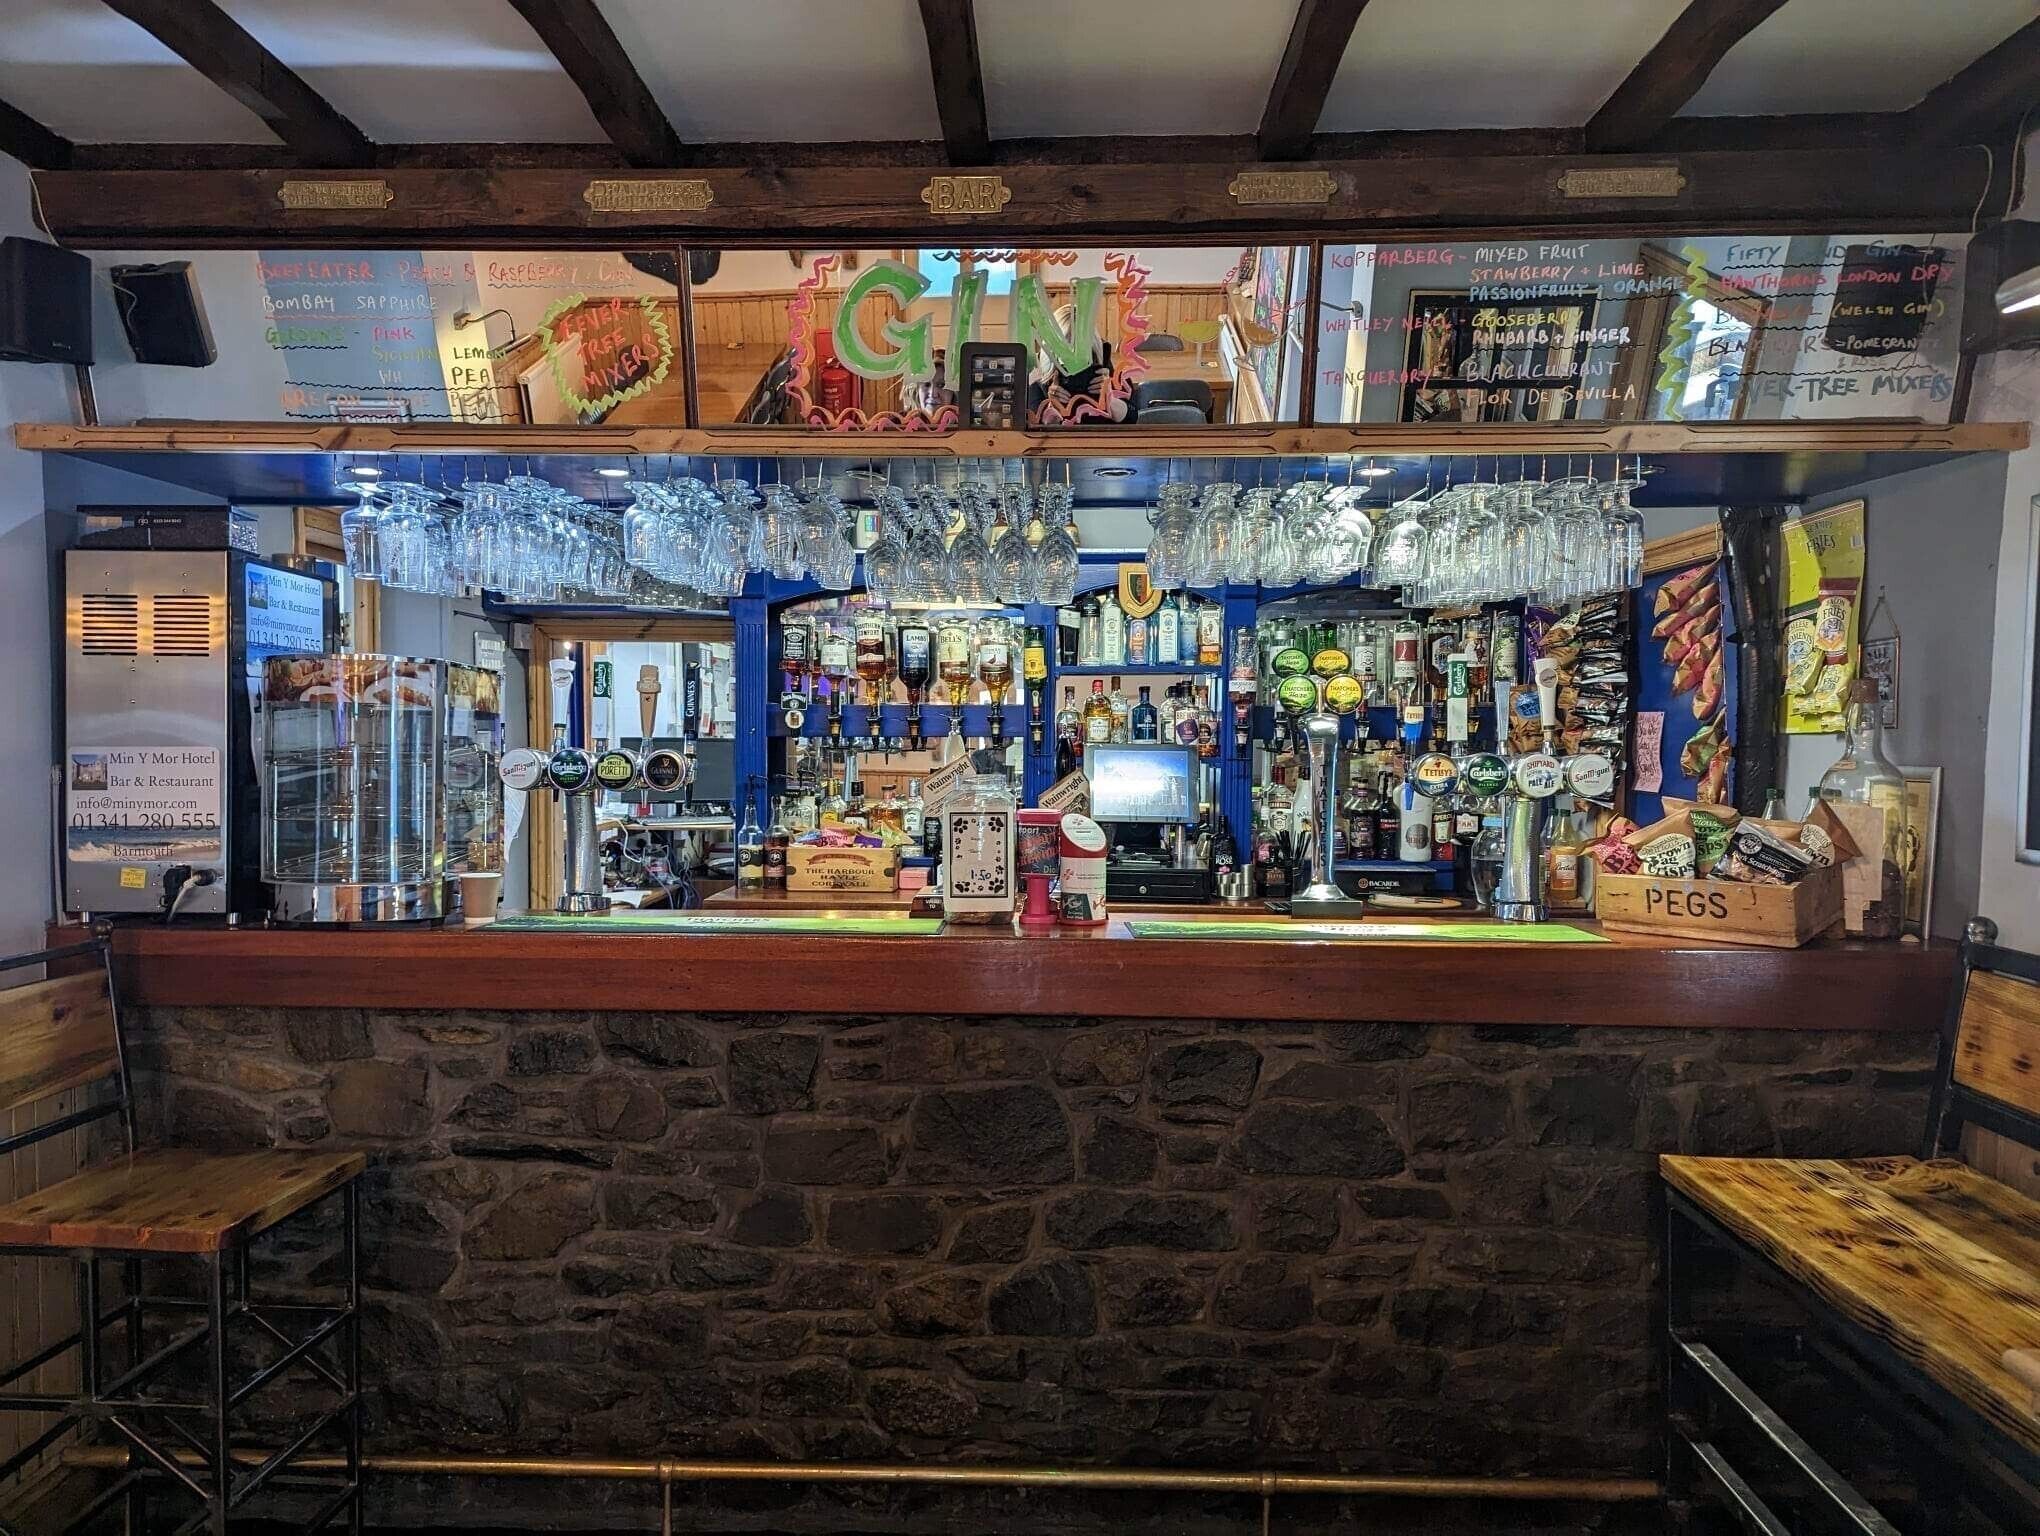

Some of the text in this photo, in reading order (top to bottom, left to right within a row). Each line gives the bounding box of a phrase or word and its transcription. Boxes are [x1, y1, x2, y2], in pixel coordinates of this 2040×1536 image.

[938, 181, 995, 209] BAR
[1331, 244, 1590, 269] KOPPARBERG MIXED FRUIT
[1727, 244, 1782, 264] FIFTY
[256, 261, 375, 281] BEEFEATER
[489, 261, 578, 284] RASPBERRY
[1470, 265, 1575, 283] STAWBERRY
[1598, 262, 1645, 277] LIME
[1838, 270, 1900, 284] LONDON
[1911, 265, 1953, 282] DRY
[1470, 284, 1589, 302] PASSIONFRUIT
[1613, 277, 1684, 295] ORANGE
[263, 294, 440, 313] BOMBAY SAPPHIRE
[1832, 301, 1895, 318] (WELSH
[1903, 298, 1945, 317] GIN)
[559, 297, 630, 339] FEVER
[832, 258, 1107, 391] GIN
[1325, 317, 1394, 334] WHITLEY
[1471, 311, 1584, 328] GOOSEBERRY
[372, 326, 416, 341] PINK
[1472, 330, 1549, 345] RHUBARB
[1573, 326, 1631, 343] GINGER
[453, 346, 506, 360] LEMON
[577, 328, 626, 366] TREE
[583, 334, 660, 392] MIXERS
[1465, 361, 1621, 383] BLACKCURRANT
[1466, 384, 1637, 406] FLOR DE SEVILLA
[1871, 373, 1954, 402] MIXERS
[1807, 534, 1837, 554] FRIES
[268, 575, 321, 596] Min Y Mor Hotel
[269, 596, 280, 608] Bar
[289, 600, 321, 616] Restaurant
[1823, 608, 1847, 621] FRIES
[940, 635, 962, 643] BELL'S
[594, 663, 607, 695] Carlsberg
[1453, 663, 1466, 696] Carlsberg
[686, 680, 697, 717] GUINNESS
[109, 751, 215, 764] Min Y Mor Hotel
[1526, 761, 1555, 770] SHIPYARD
[552, 761, 588, 775] Carlsberg
[600, 766, 628, 776] PORETTI
[926, 760, 970, 793] Wainwright
[1469, 766, 1505, 779] Carlsberg
[111, 776, 214, 787] Bar & Restaurant
[1041, 774, 1084, 809] Wainwright
[1528, 779, 1555, 789] PALE ALE
[76, 797, 197, 811] info@minymor.com
[72, 812, 216, 831] 01341 280 555
[1320, 764, 1328, 867] THATCHERS
[113, 844, 173, 857] Barmouth
[1647, 861, 1697, 878] Crisps
[1749, 858, 1786, 879] Scratchings
[1645, 888, 1728, 919] PEGS
